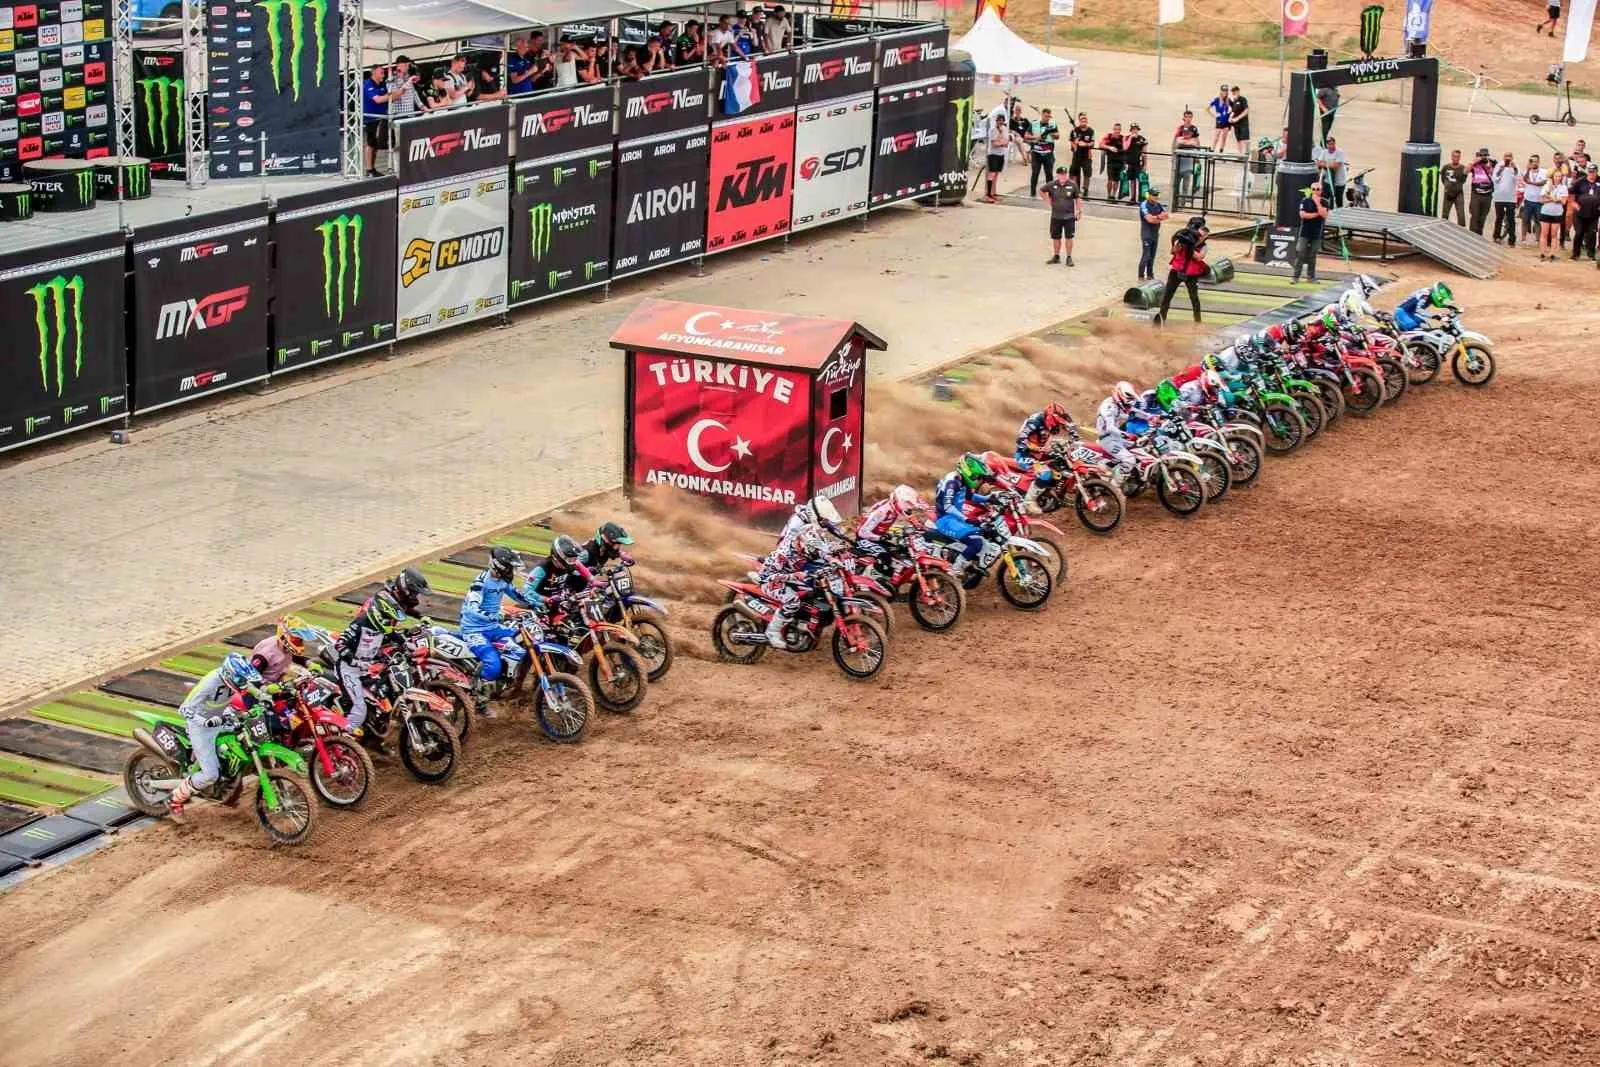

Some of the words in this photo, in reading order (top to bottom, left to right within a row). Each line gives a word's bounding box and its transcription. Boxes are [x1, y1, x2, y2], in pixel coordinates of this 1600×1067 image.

[1351, 59, 1399, 76] MONSTER
[654, 144, 676, 156] AIROH
[686, 137, 706, 150] AIROH
[621, 150, 642, 163] AIROH
[715, 156, 788, 212] KTM
[627, 181, 697, 225] AIROH
[552, 204, 596, 224] MONSTER
[649, 247, 671, 260] AIROH
[680, 239, 702, 252] AIROH
[616, 256, 638, 269] AIROH
[155, 285, 250, 340] MXGP
[656, 332, 785, 356] AFYONKARAHISAR
[646, 469, 796, 505] AFYONKARAHISAR
[156, 729, 176, 750] 158
